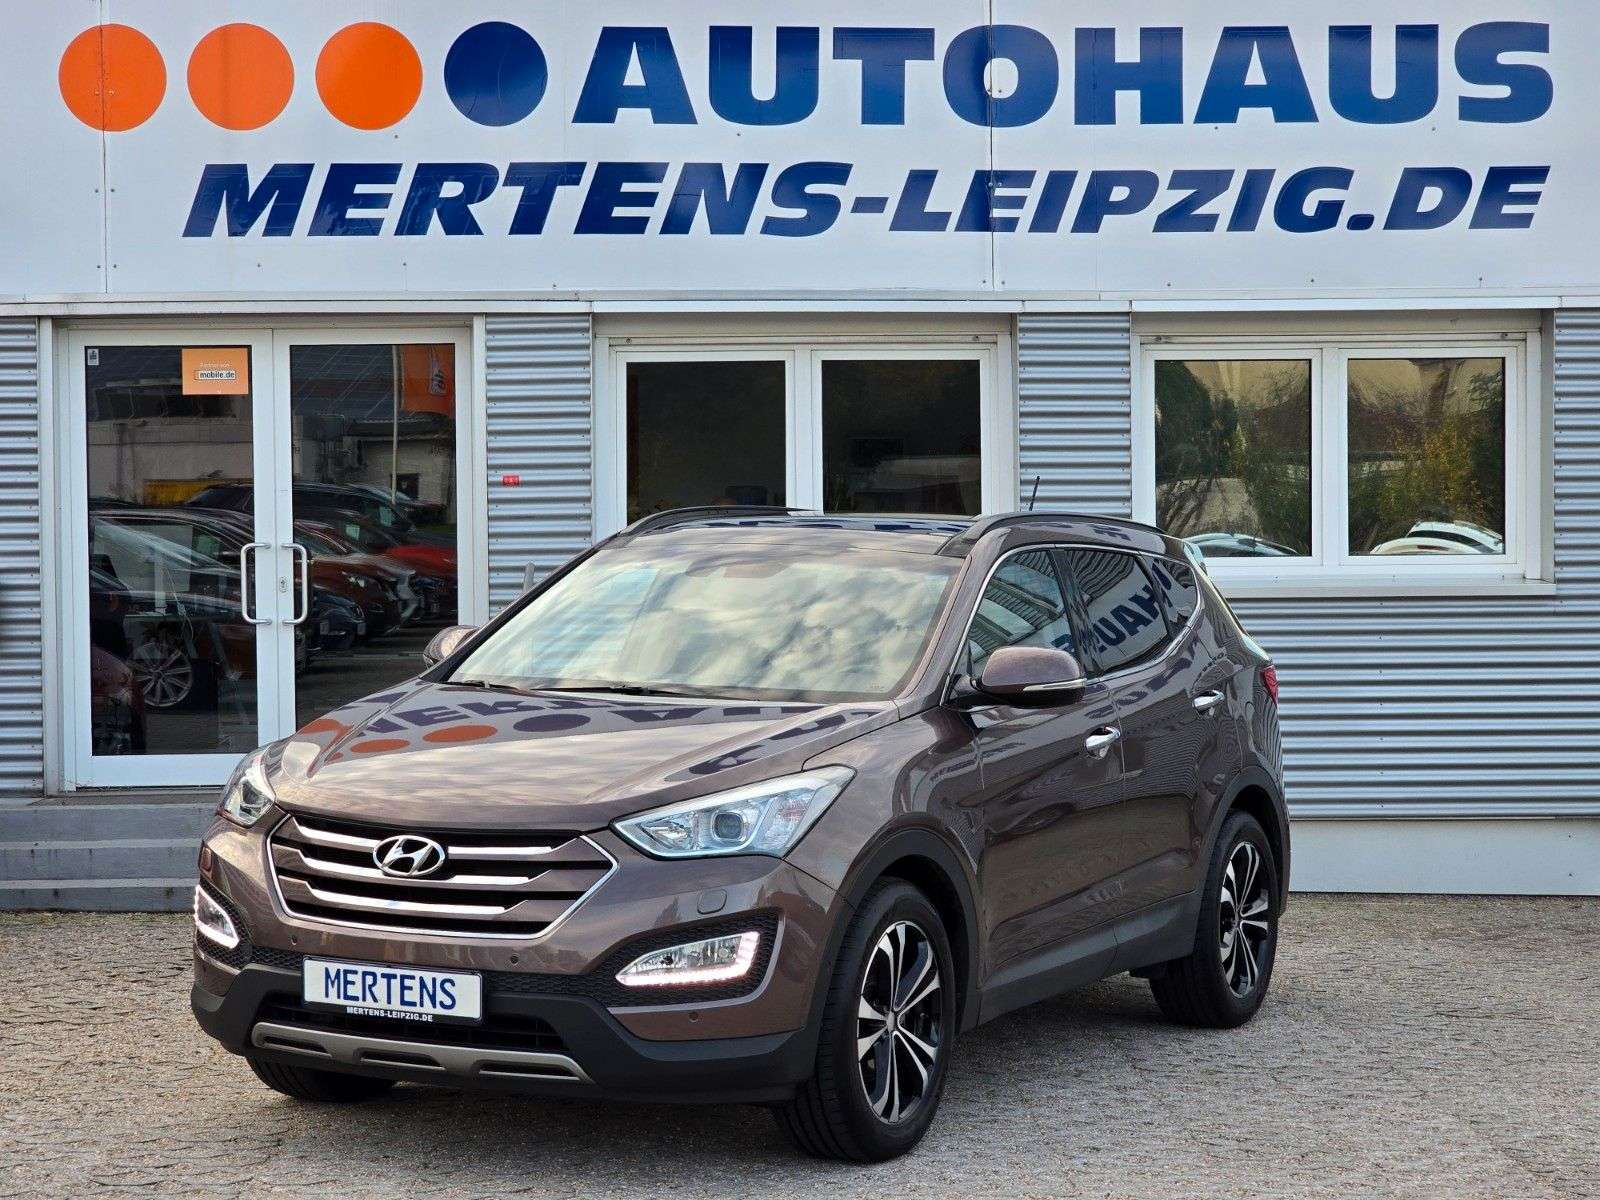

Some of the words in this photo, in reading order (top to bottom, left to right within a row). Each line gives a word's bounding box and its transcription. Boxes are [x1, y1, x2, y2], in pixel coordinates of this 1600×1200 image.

[571, 22, 1554, 129] AUTOHAUS
[181, 161, 1551, 238] MERTENS-LEIPZIG.DE
[199, 371, 235, 379] mobile.de
[324, 967, 457, 1011] MERTENS
[346, 1006, 433, 1022] MERTENS-LEIPZIG.DE
